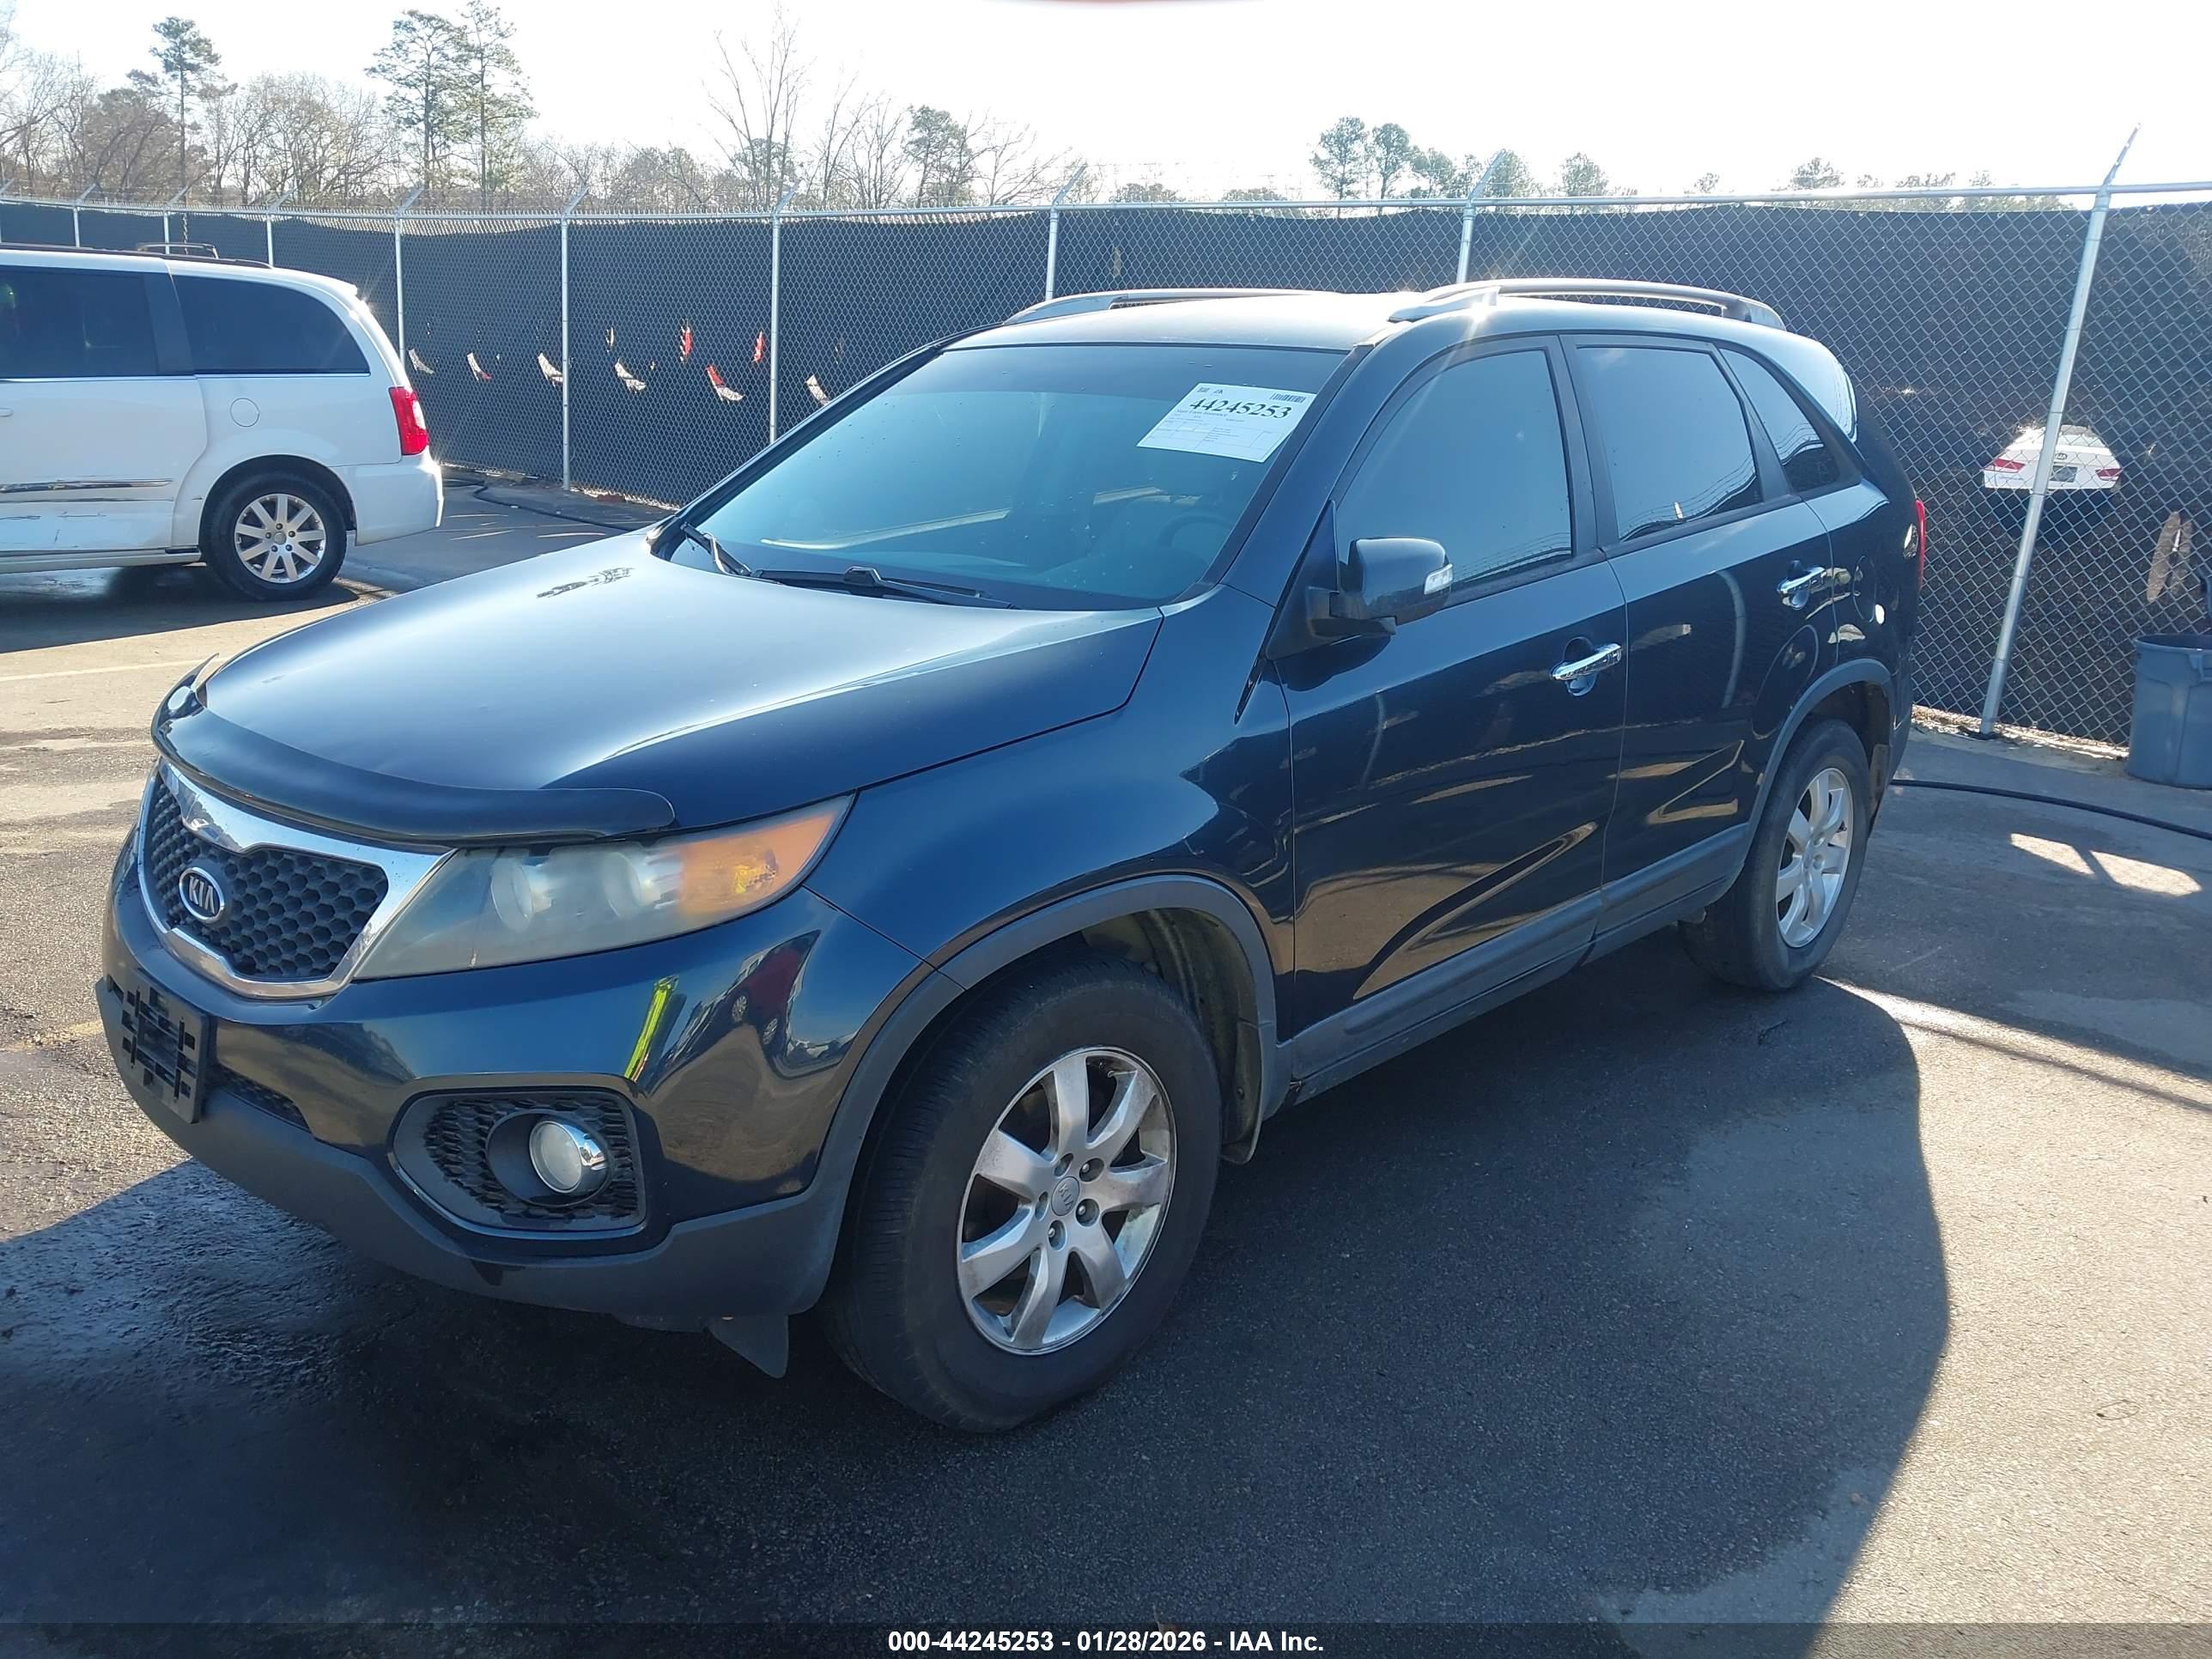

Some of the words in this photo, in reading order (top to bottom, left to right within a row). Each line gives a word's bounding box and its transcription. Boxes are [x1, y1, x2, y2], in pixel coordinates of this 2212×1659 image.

[1189, 398, 1292, 419] 44245253
[188, 874, 216, 915] KIA
[1057, 1182, 1074, 1211] KIA
